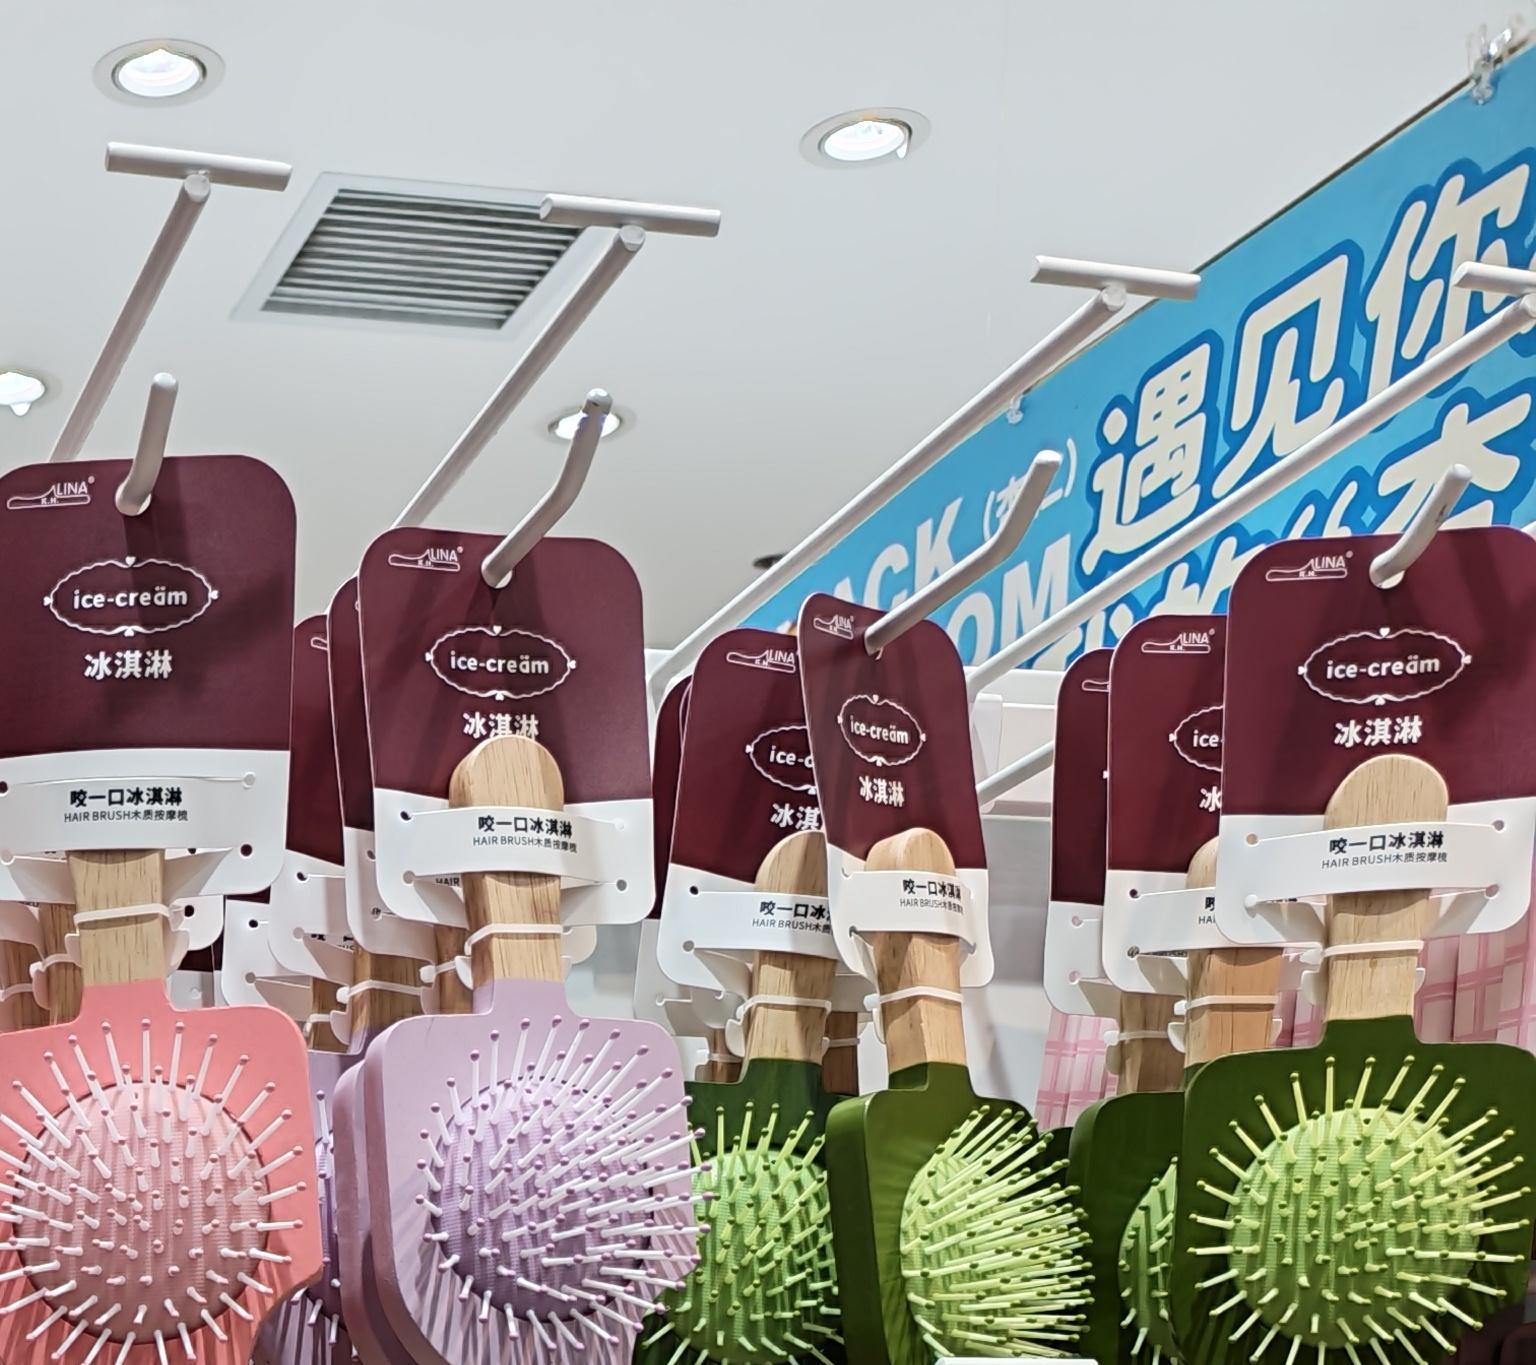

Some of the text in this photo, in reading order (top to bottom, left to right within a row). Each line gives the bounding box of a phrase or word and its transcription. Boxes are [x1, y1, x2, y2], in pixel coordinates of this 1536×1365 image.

[73, 584, 188, 610] ice-creäm
[83, 649, 173, 680] 冰淇淋
[450, 650, 549, 675] ice-creäm
[1326, 655, 1440, 680] ice-creäm
[462, 711, 540, 739] 冰淇淋
[850, 716, 909, 745] ice-creäm
[1334, 716, 1422, 748] 冰淇淋
[769, 745, 815, 767] ice-c
[70, 786, 183, 808] 咬一口冰淇淋
[858, 776, 905, 808] 冰淇淋
[64, 811, 91, 822] HAIR
[477, 815, 573, 839] 咬一口冰淇淋
[769, 803, 823, 831] 冰淇
[472, 835, 498, 847] HAIR
[1329, 831, 1444, 855] 咬一口冰淇淋
[1321, 856, 1349, 869] HAIR
[759, 900, 831, 921] 咬一口冰
[899, 897, 919, 908] HAIR
[752, 918, 777, 929] HAIR
